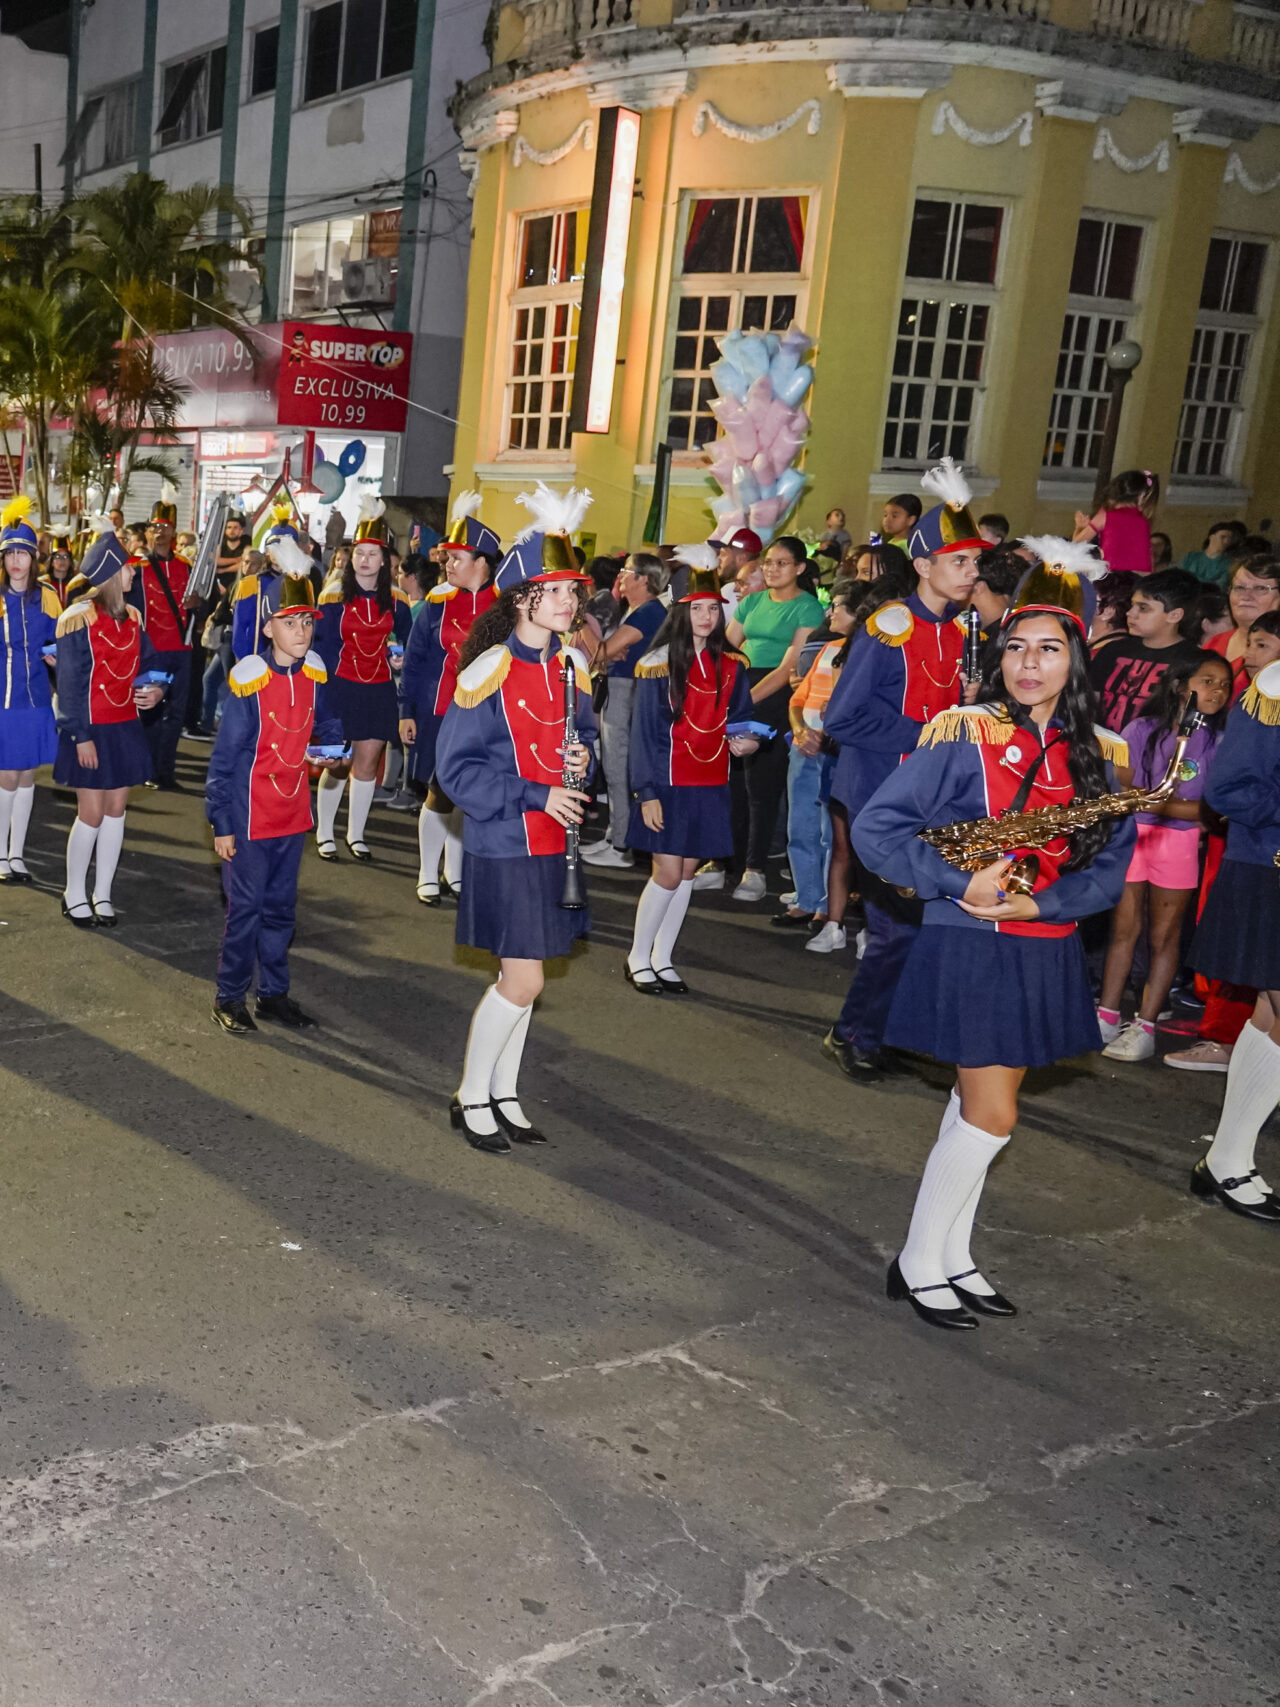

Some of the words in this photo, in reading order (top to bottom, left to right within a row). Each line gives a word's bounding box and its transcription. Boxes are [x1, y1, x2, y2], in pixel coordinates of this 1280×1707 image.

[310, 340, 366, 362] SUPER
[370, 344, 404, 365] TOP
[293, 376, 395, 400] EXCLUSIVA
[320, 403, 366, 425] 10,99
